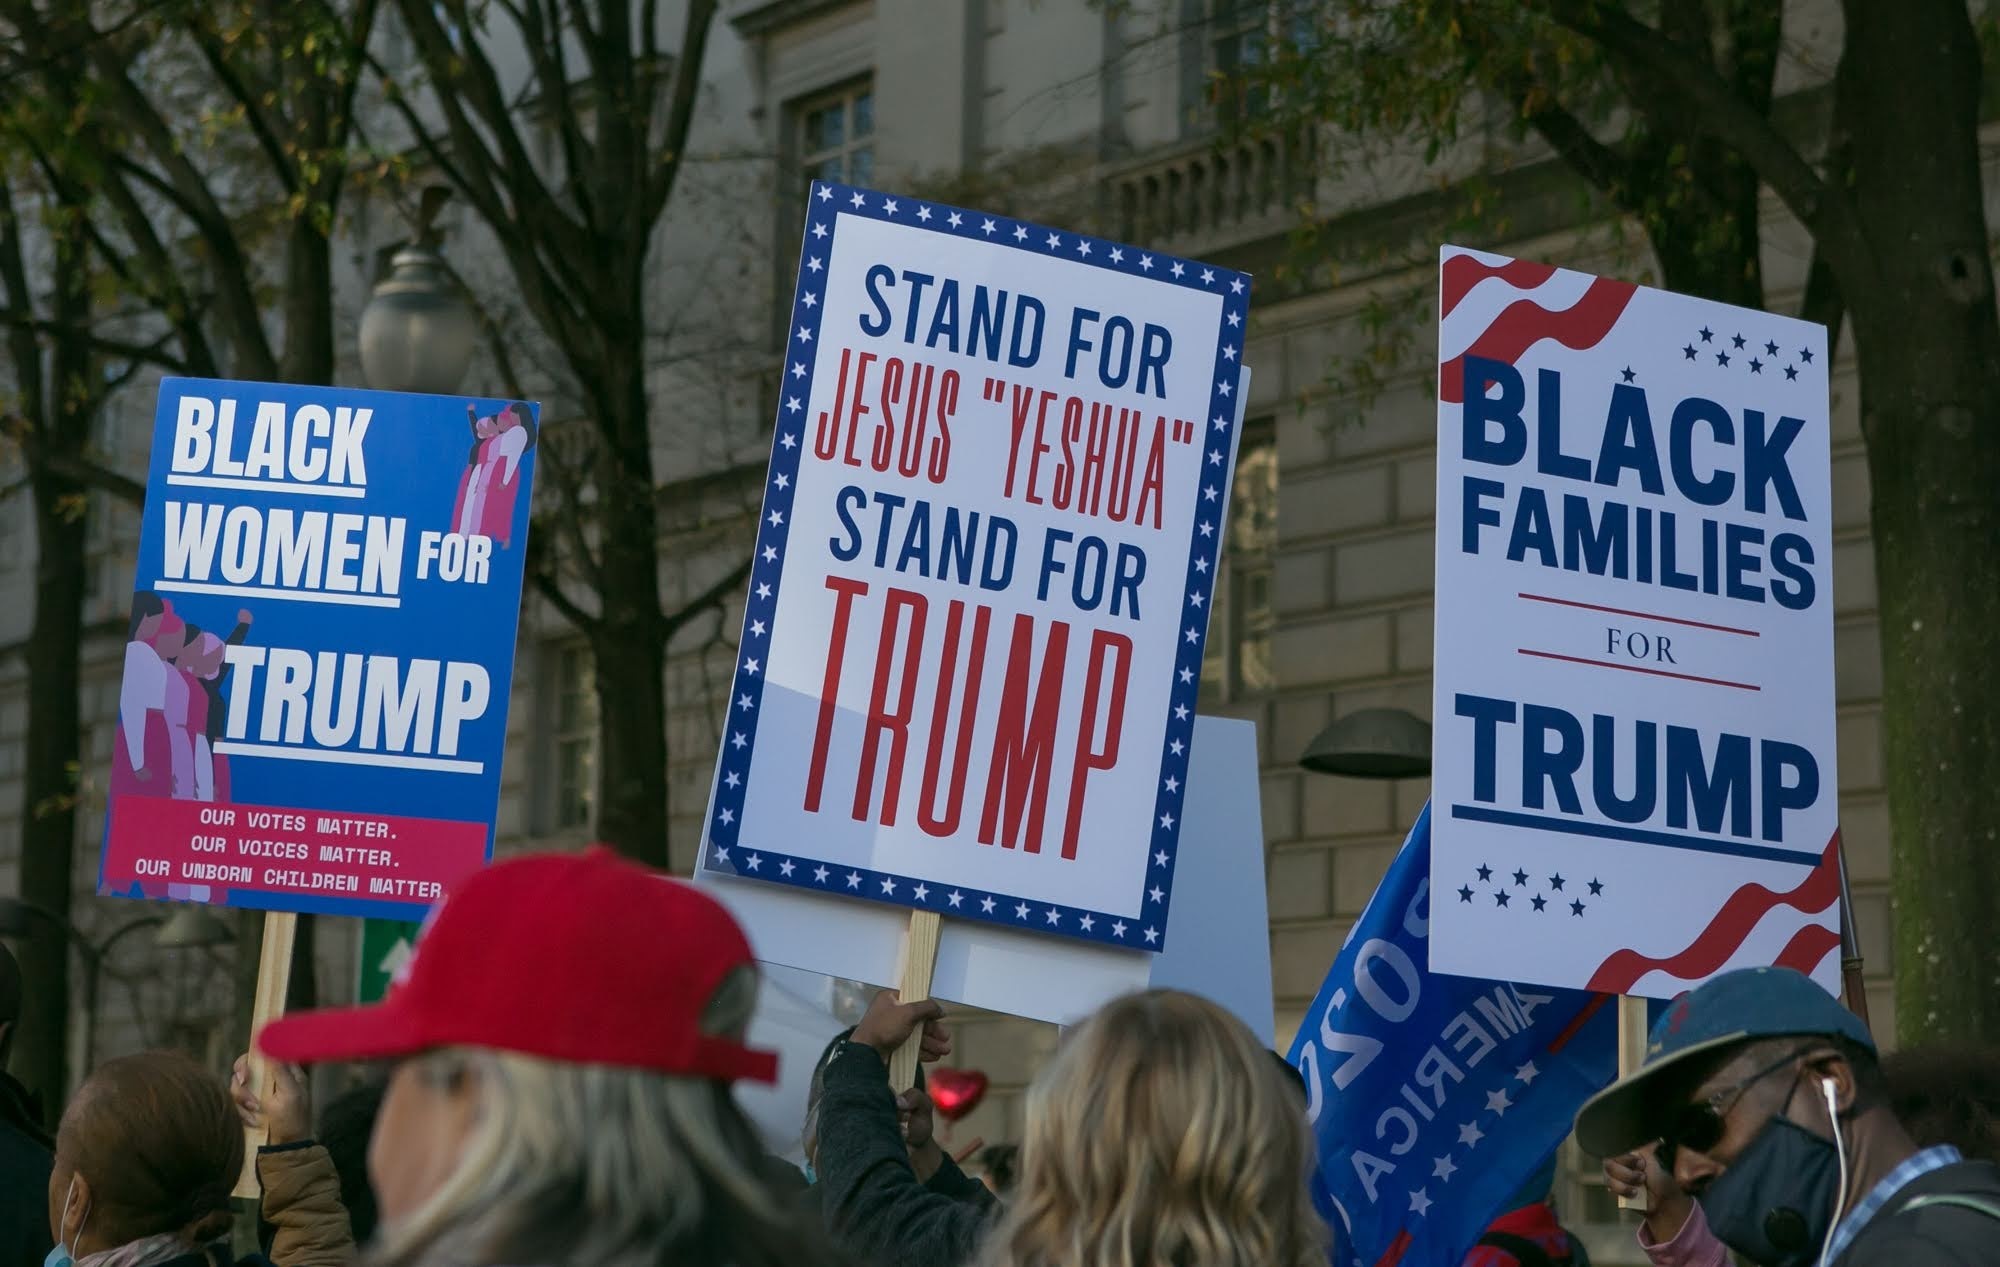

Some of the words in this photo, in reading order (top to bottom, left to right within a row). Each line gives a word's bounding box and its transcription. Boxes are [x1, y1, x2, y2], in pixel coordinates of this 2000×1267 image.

[860, 265, 1045, 368] STAND
[1065, 307, 1172, 399] FOR
[172, 396, 373, 484] BLACK
[814, 348, 960, 484] JESUS
[983, 378, 1193, 529] "YESHUA"
[1463, 356, 1807, 522] BLACK
[165, 502, 406, 594] WOMEN
[417, 531, 491, 583] FOR
[830, 486, 1017, 591] STAND
[1037, 528, 1146, 620] FOR
[1463, 476, 1815, 610] FAMILIES
[225, 644, 491, 756] TRUMP
[1605, 627, 1678, 665] FOR
[803, 575, 1133, 860] TRUMP
[1455, 693, 1819, 842] TRUMP
[136, 859, 170, 876] OUR
[182, 863, 252, 882] UNBORN
[264, 869, 358, 891] CHILDREN
[192, 835, 226, 852] OUR
[239, 839, 308, 859] VOICES
[320, 846, 399, 867] MATTER.
[201, 809, 235, 825] OUR
[248, 812, 305, 831] VOTES
[317, 818, 396, 839] MATTER.
